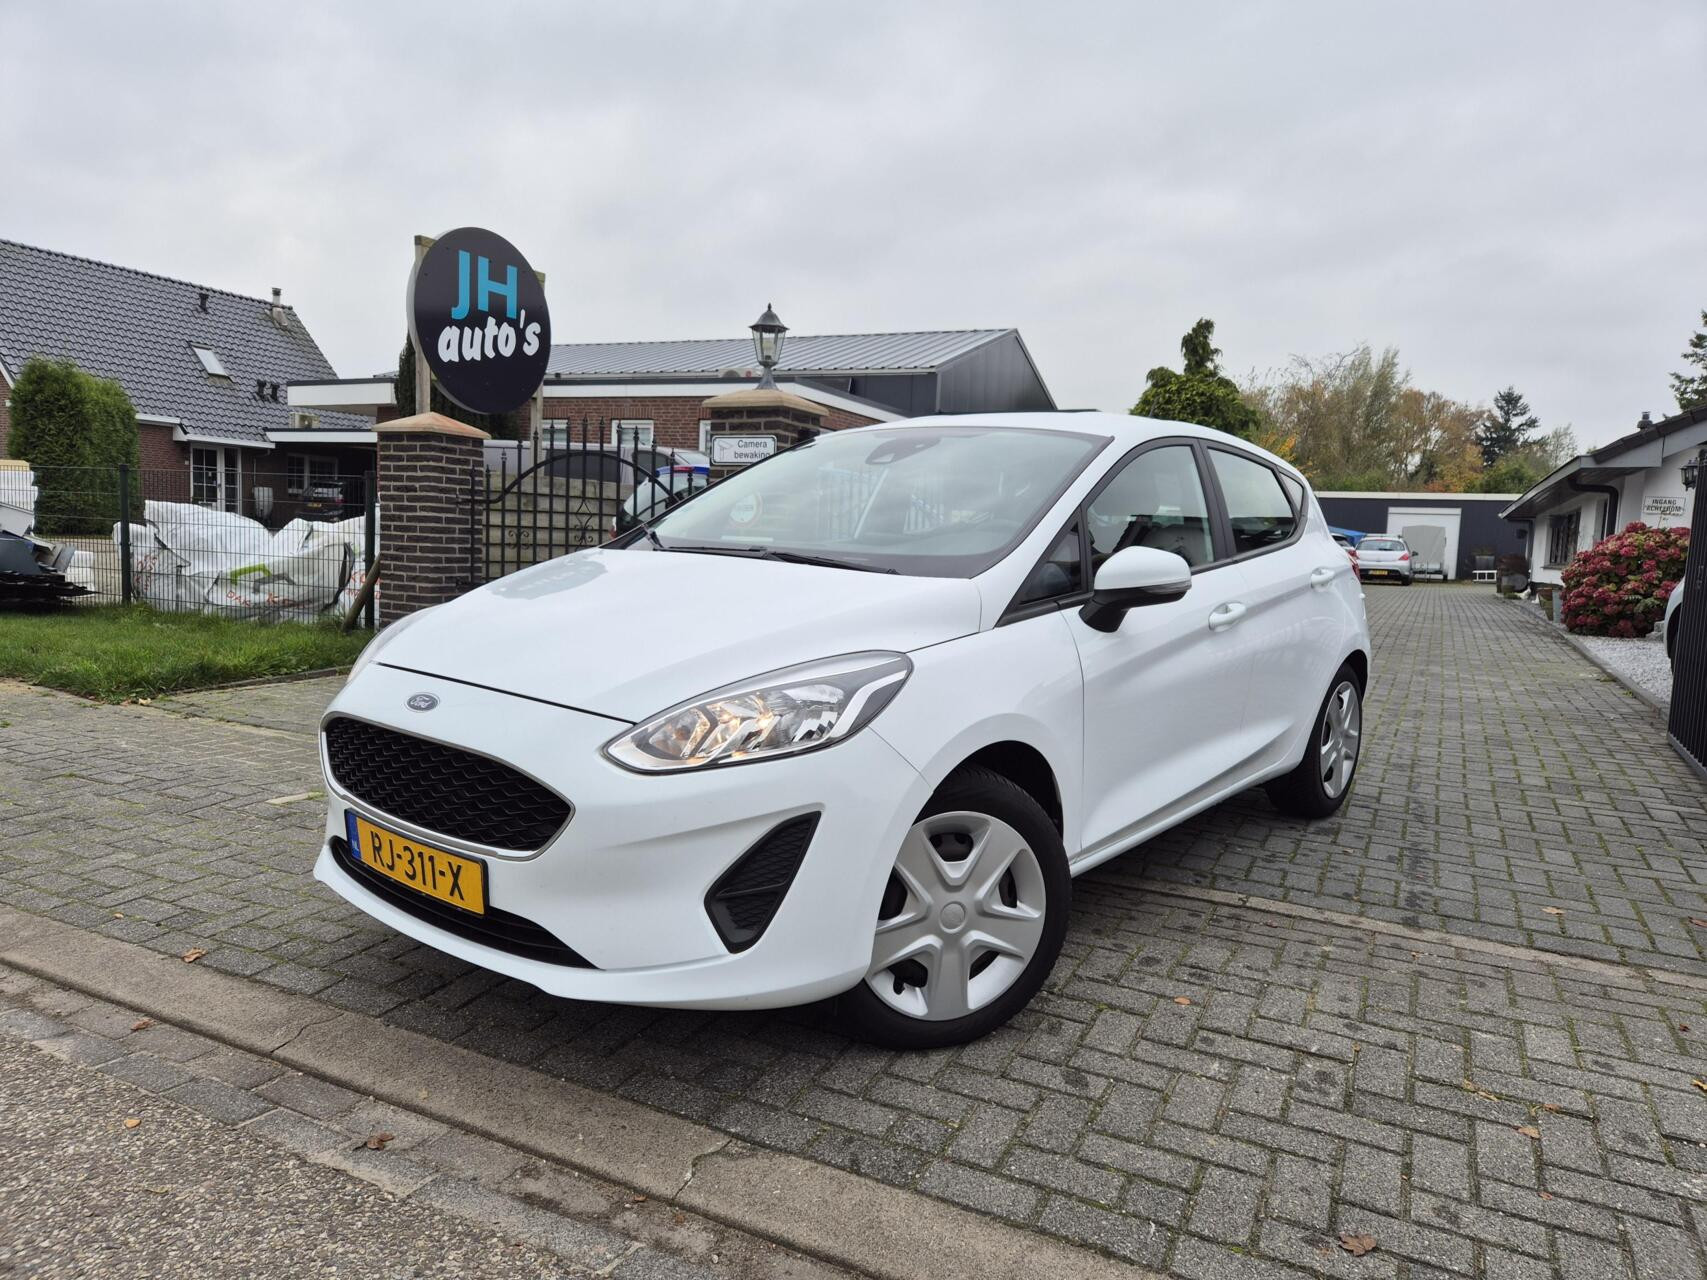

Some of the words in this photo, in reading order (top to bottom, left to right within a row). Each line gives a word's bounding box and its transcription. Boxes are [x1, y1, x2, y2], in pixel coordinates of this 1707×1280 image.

[451, 250, 518, 320] JH
[437, 308, 542, 363] auto's
[737, 439, 768, 448] Camera
[370, 830, 465, 901] RJ-311-X
